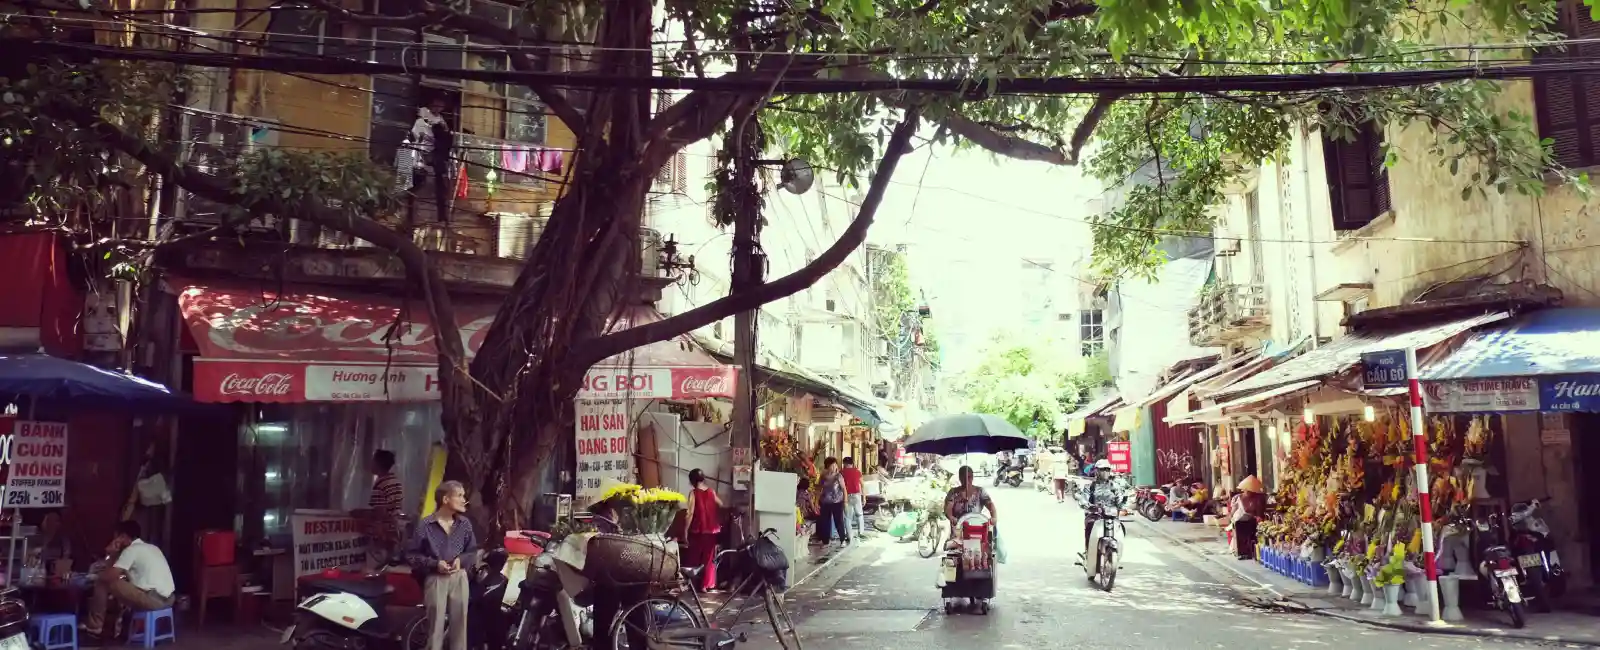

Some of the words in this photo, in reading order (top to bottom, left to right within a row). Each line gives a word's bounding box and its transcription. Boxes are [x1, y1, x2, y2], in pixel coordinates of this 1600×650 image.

[332, 370, 377, 385] Hương
[379, 372, 406, 384] Anh
[583, 375, 608, 391] NG
[615, 373, 653, 391] BƠI
[1366, 366, 1388, 382] CẦU
[1390, 364, 1405, 381] GỖ
[219, 372, 294, 396] Coca-Cola
[681, 376, 729, 395] Coca-Cola
[1553, 380, 1600, 398] Han
[9, 491, 31, 504] 25k
[41, 491, 63, 504] 30k
